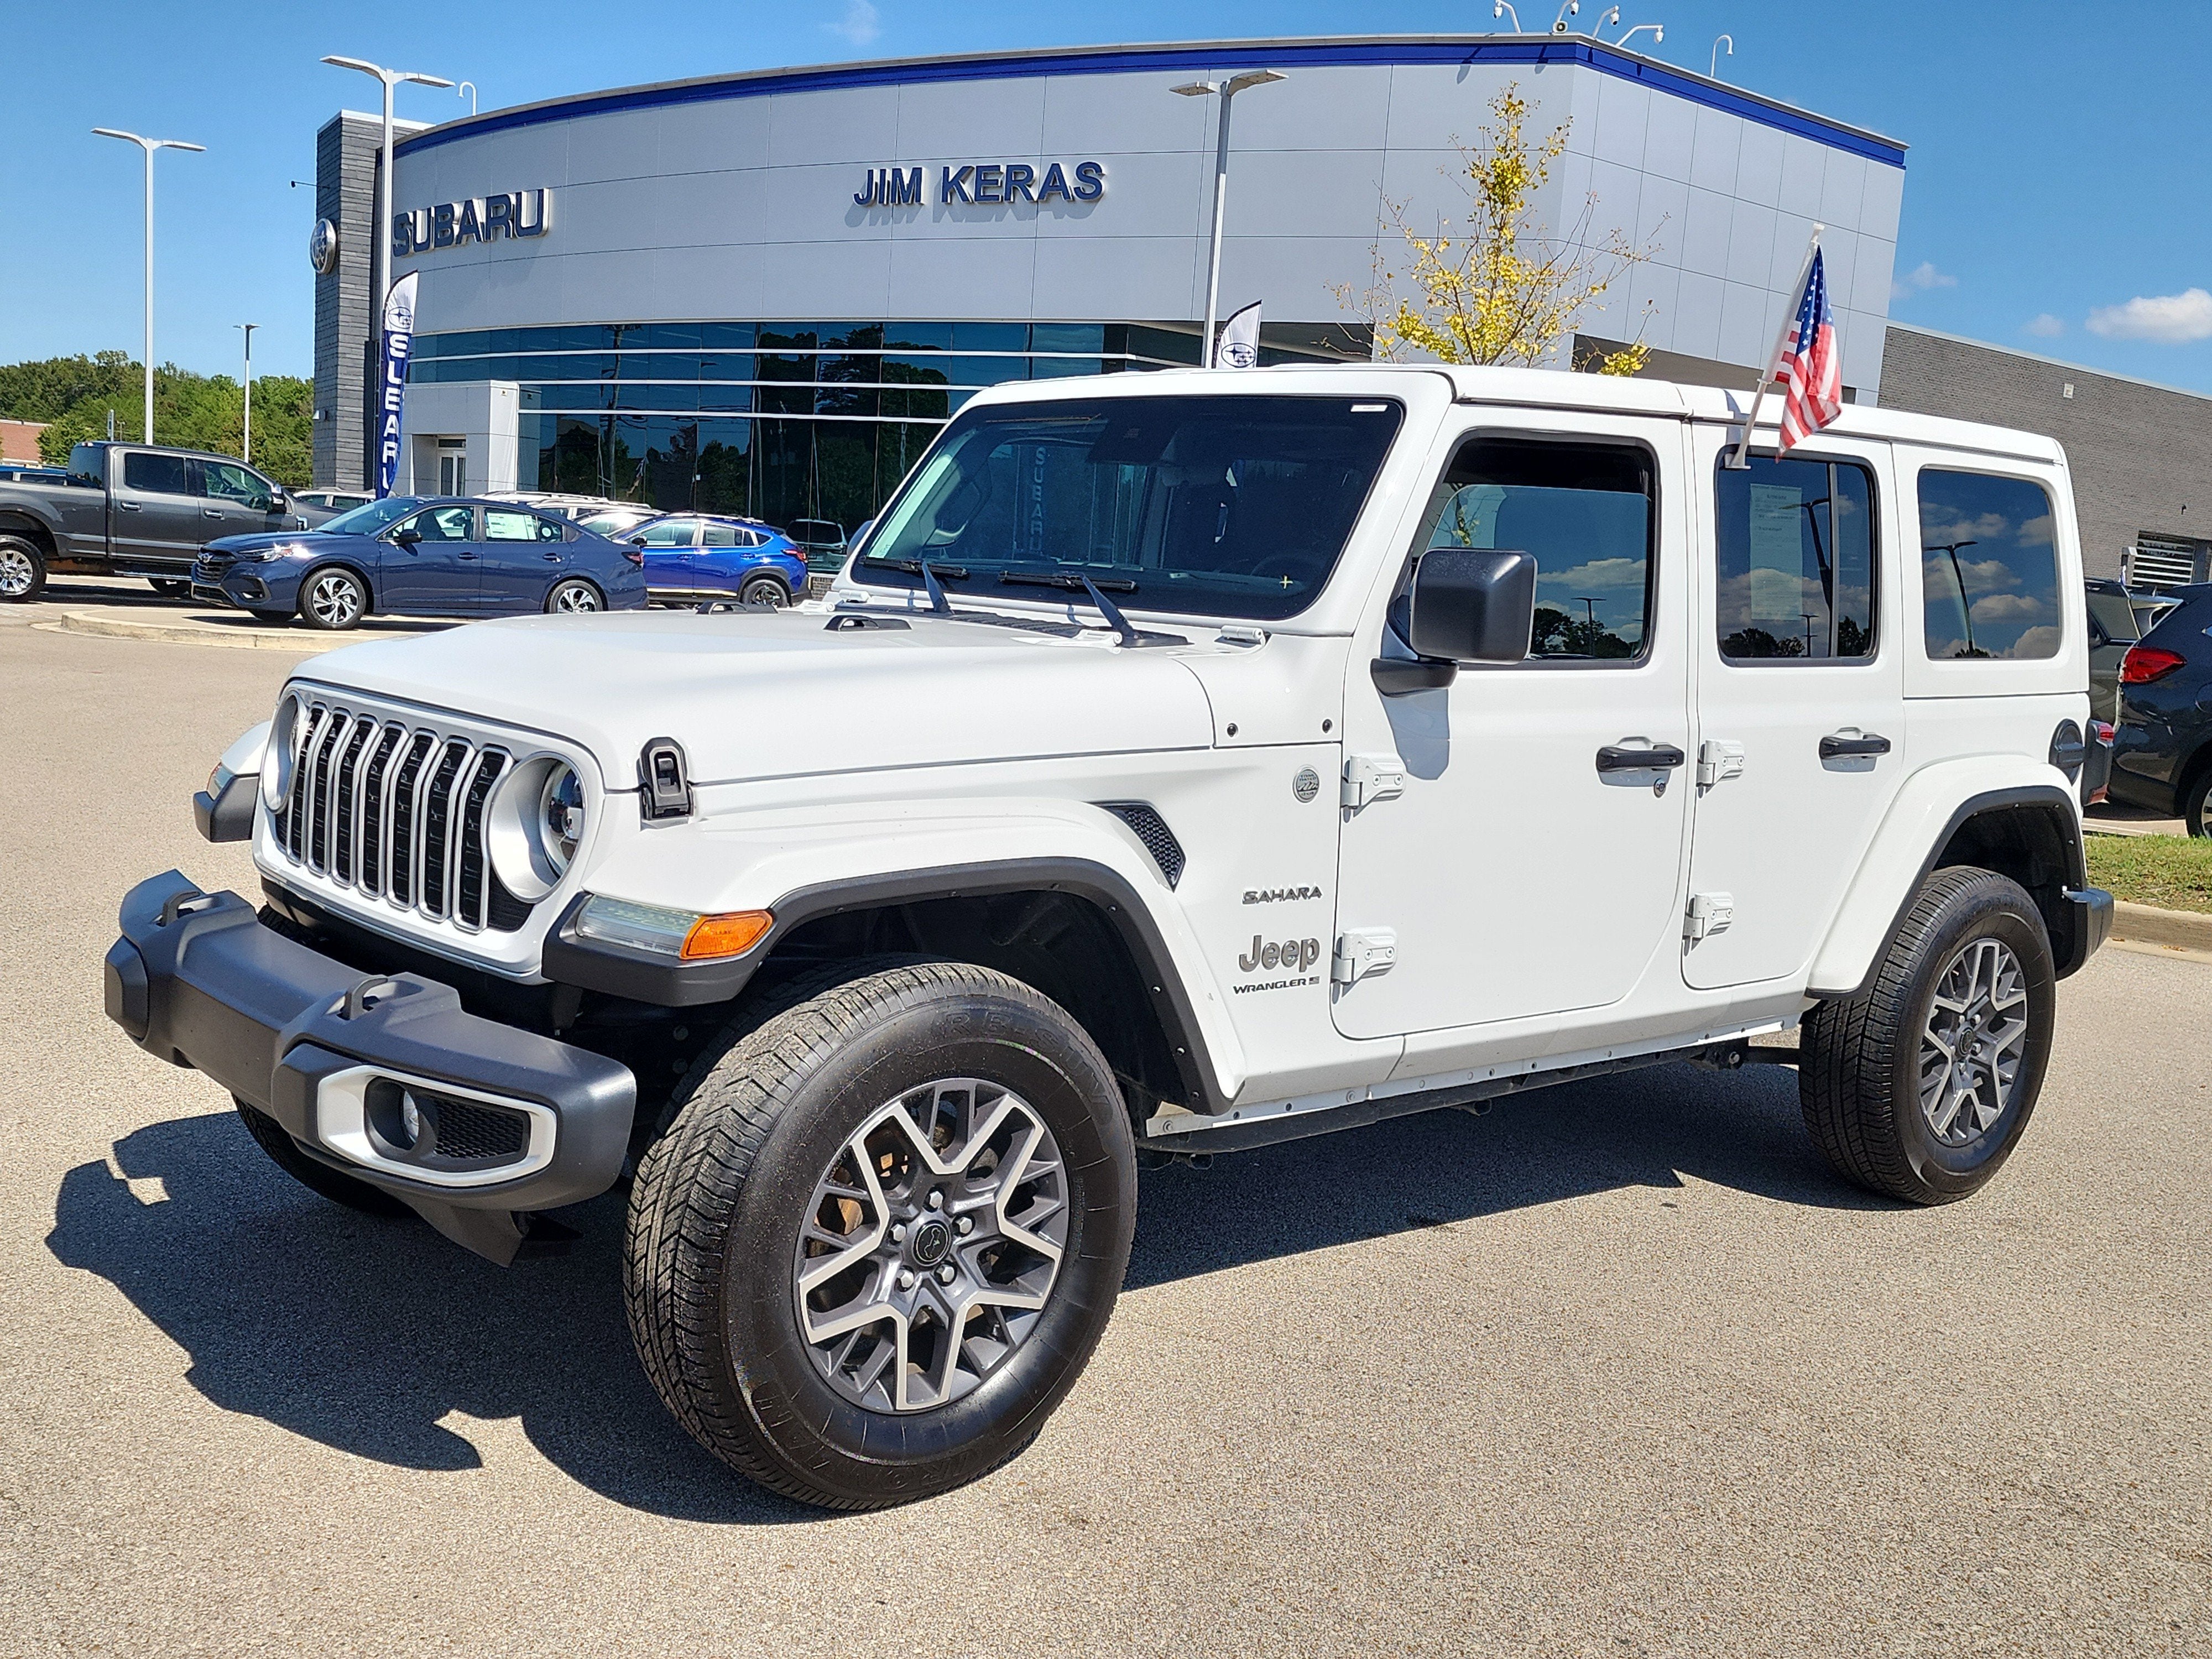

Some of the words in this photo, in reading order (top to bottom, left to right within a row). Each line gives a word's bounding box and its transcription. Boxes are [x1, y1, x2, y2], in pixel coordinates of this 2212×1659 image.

[853, 166, 925, 206] JIM
[940, 160, 1105, 204] KERAS
[393, 187, 551, 257] SUBARU
[1242, 885, 1323, 905] SAHARA
[1238, 935, 1321, 973] Jeep
[1233, 978, 1307, 994] WRANGLER
